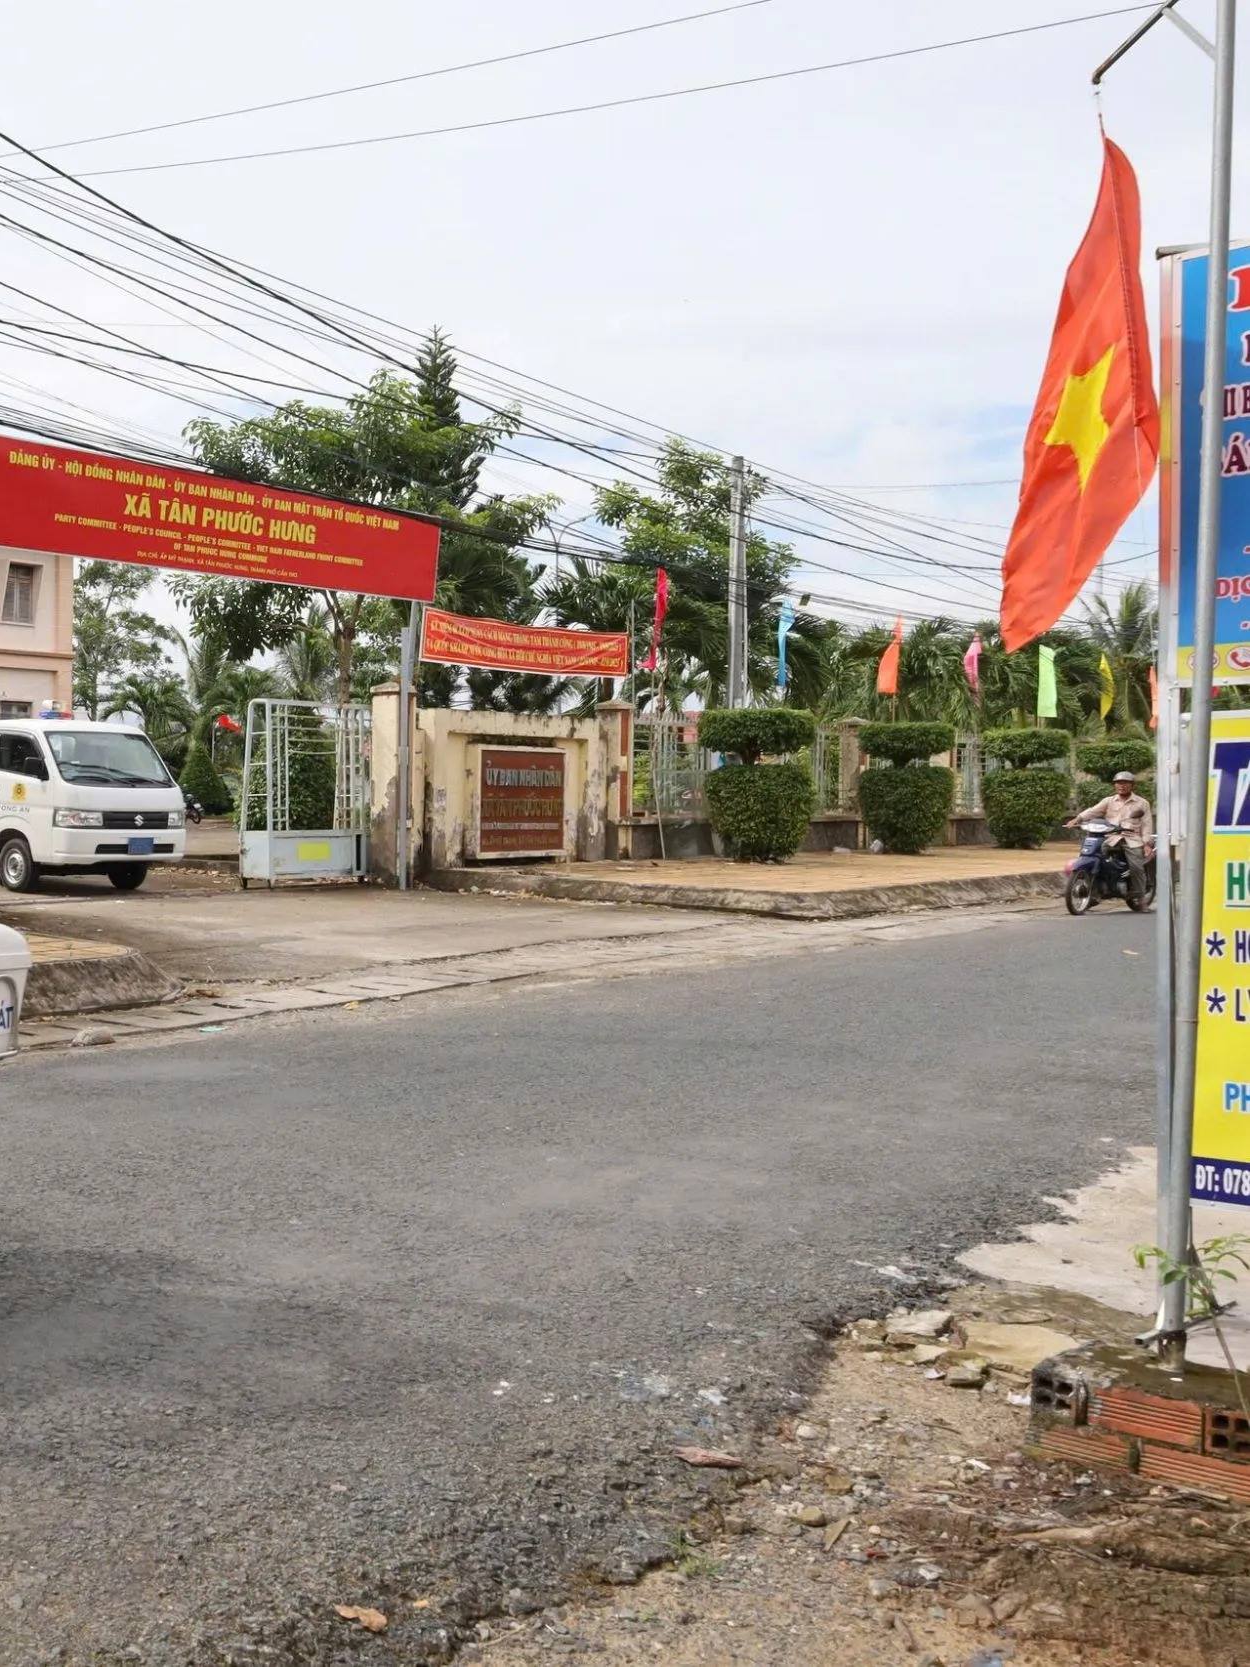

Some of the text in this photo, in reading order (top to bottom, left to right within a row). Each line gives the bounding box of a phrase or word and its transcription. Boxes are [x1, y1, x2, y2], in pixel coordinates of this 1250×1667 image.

[9, 448, 39, 468] ĐẢNG
[42, 453, 56, 470] ỦY
[65, 460, 82, 478] HỘI
[85, 463, 113, 480] ĐỒNG
[116, 469, 144, 485] NHÂN
[146, 474, 165, 490] DÂN
[174, 478, 186, 493] ỦY
[188, 482, 207, 497] BAN
[210, 487, 234, 502] NHÂN
[236, 491, 254, 506] DÂN
[262, 494, 273, 508] ỦY
[274, 499, 291, 512] BAN
[312, 503, 332, 519] TRẬN
[344, 509, 365, 525] QUỐC
[366, 513, 381, 528] VIỆT
[382, 518, 400, 531] NAM
[54, 513, 77, 524] PARTY
[78, 517, 117, 530] COMMITTEE
[123, 523, 154, 535] PEOPLE'S
[155, 528, 182, 540] COUNCIL
[187, 533, 217, 546] PEOPLE'S
[217, 538, 251, 551] COMMITTEE
[334, 555, 364, 567] COMMITTEE
[124, 492, 316, 544] XÃ TÂN PHƯỚC HƯNG
[173, 542, 182, 551] OF
[1195, 1164, 1219, 1192] ĐT:
